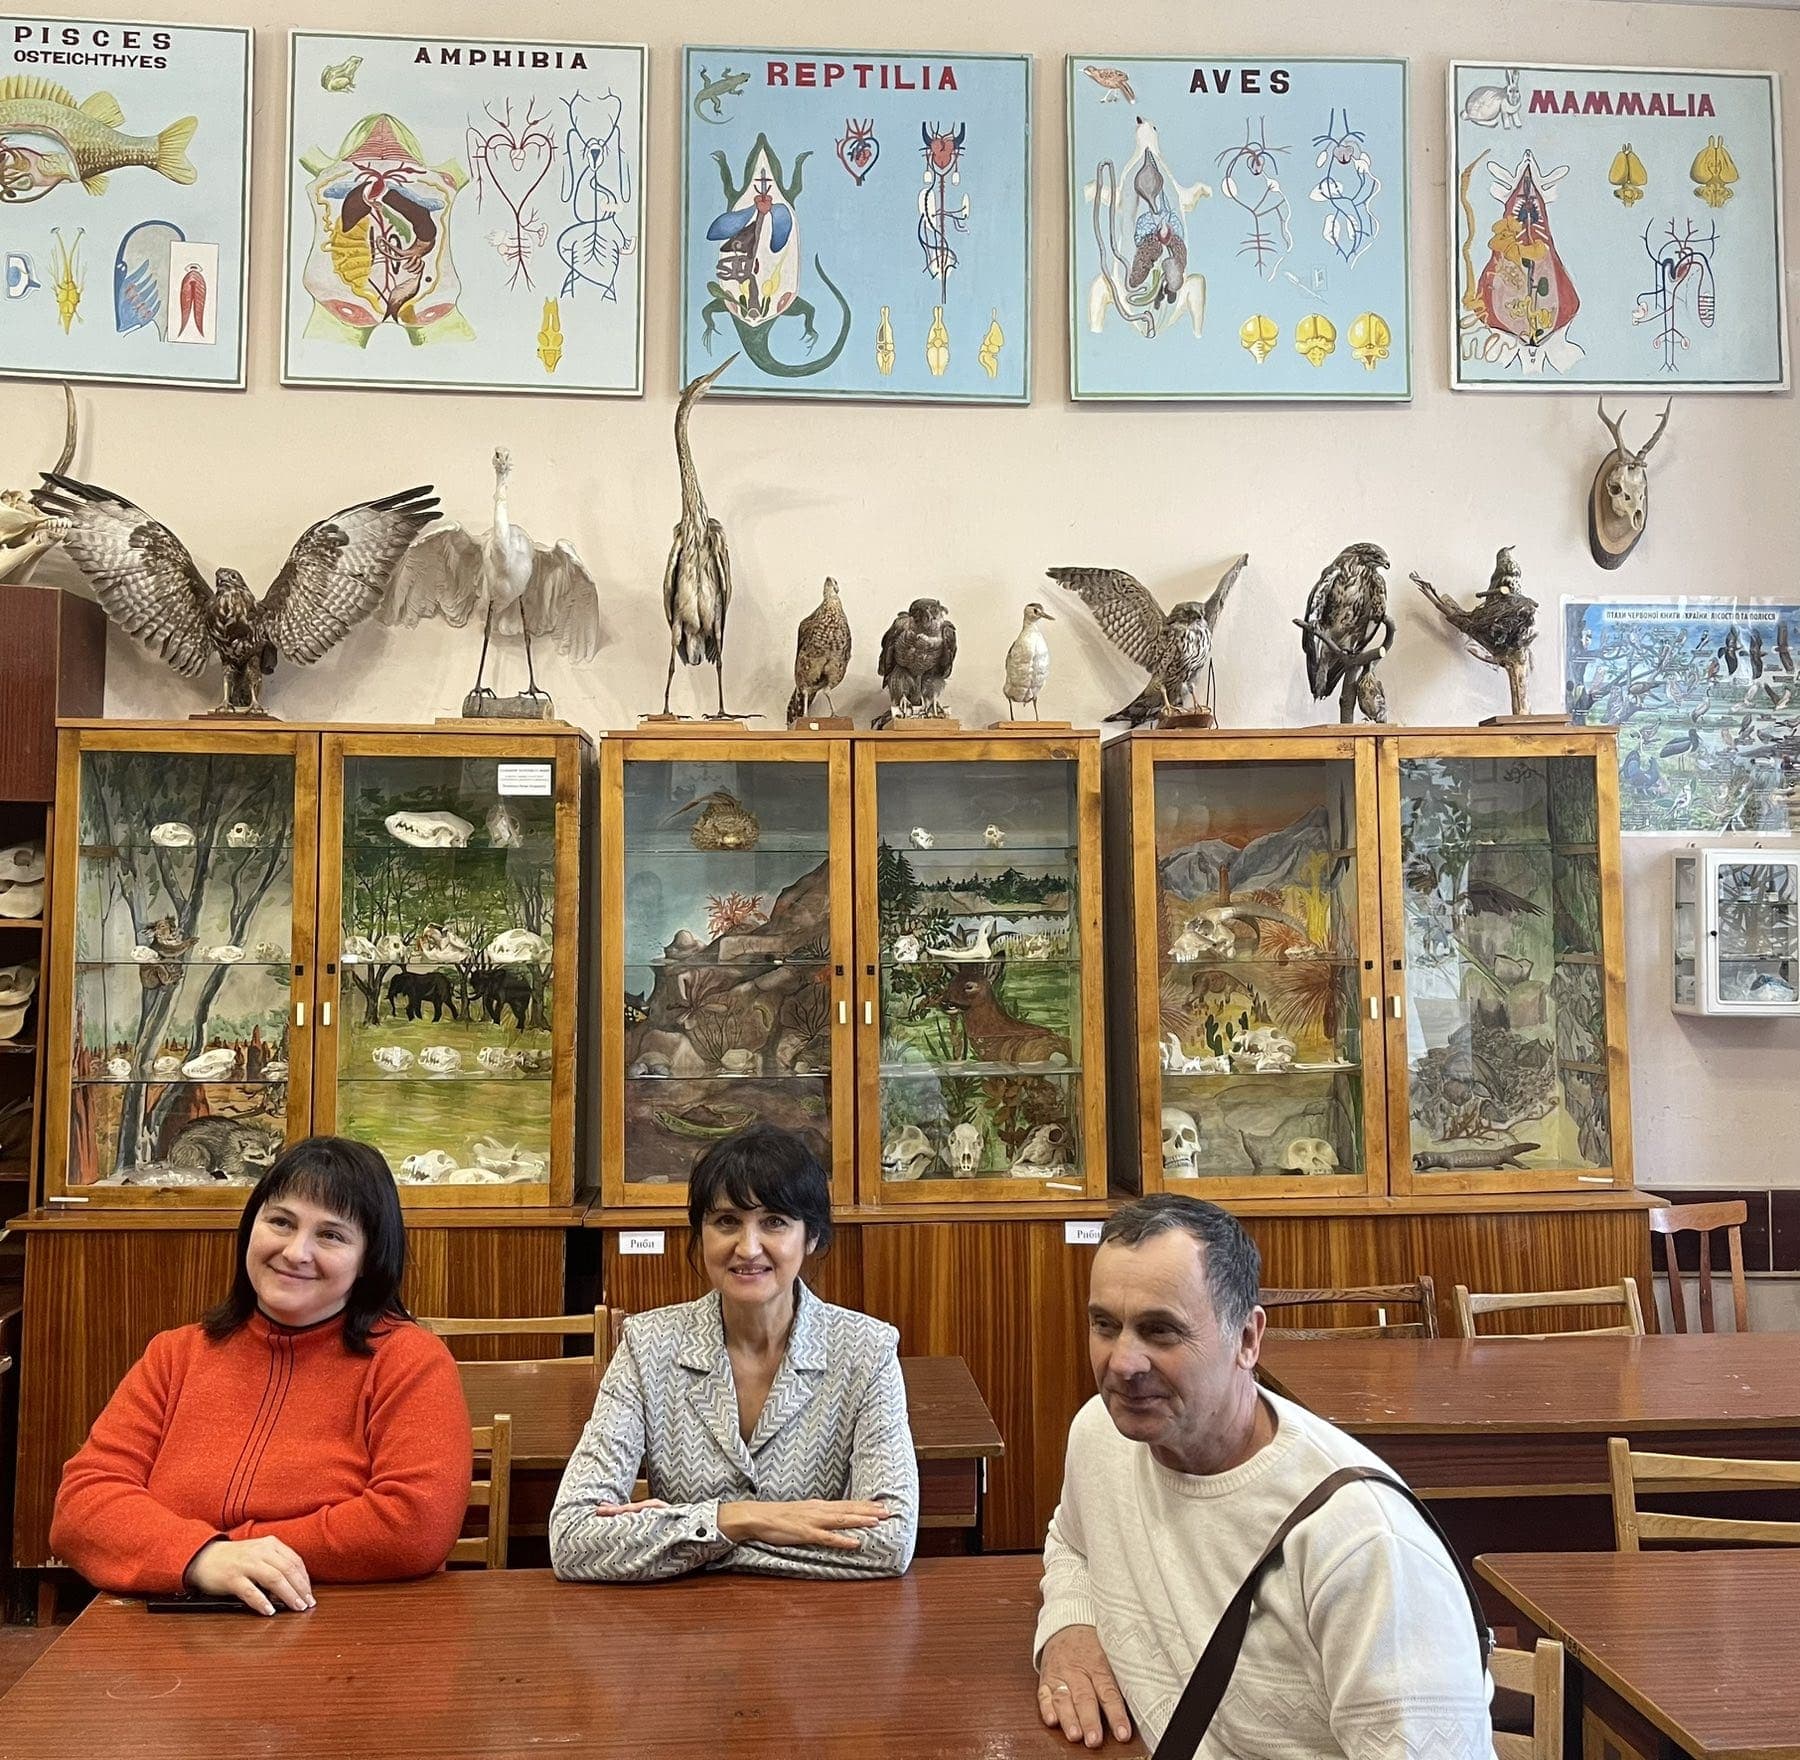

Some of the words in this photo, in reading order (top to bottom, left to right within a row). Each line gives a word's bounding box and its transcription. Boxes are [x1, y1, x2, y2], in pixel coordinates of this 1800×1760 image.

[14, 26, 171, 50] PISCES
[14, 49, 167, 69] OSTEICHTHYES
[414, 47, 588, 70] AMPHIBIA
[766, 61, 958, 91] REPTILIA
[1189, 69, 1290, 94] AVES
[1528, 89, 1716, 117] MAMMALIA
